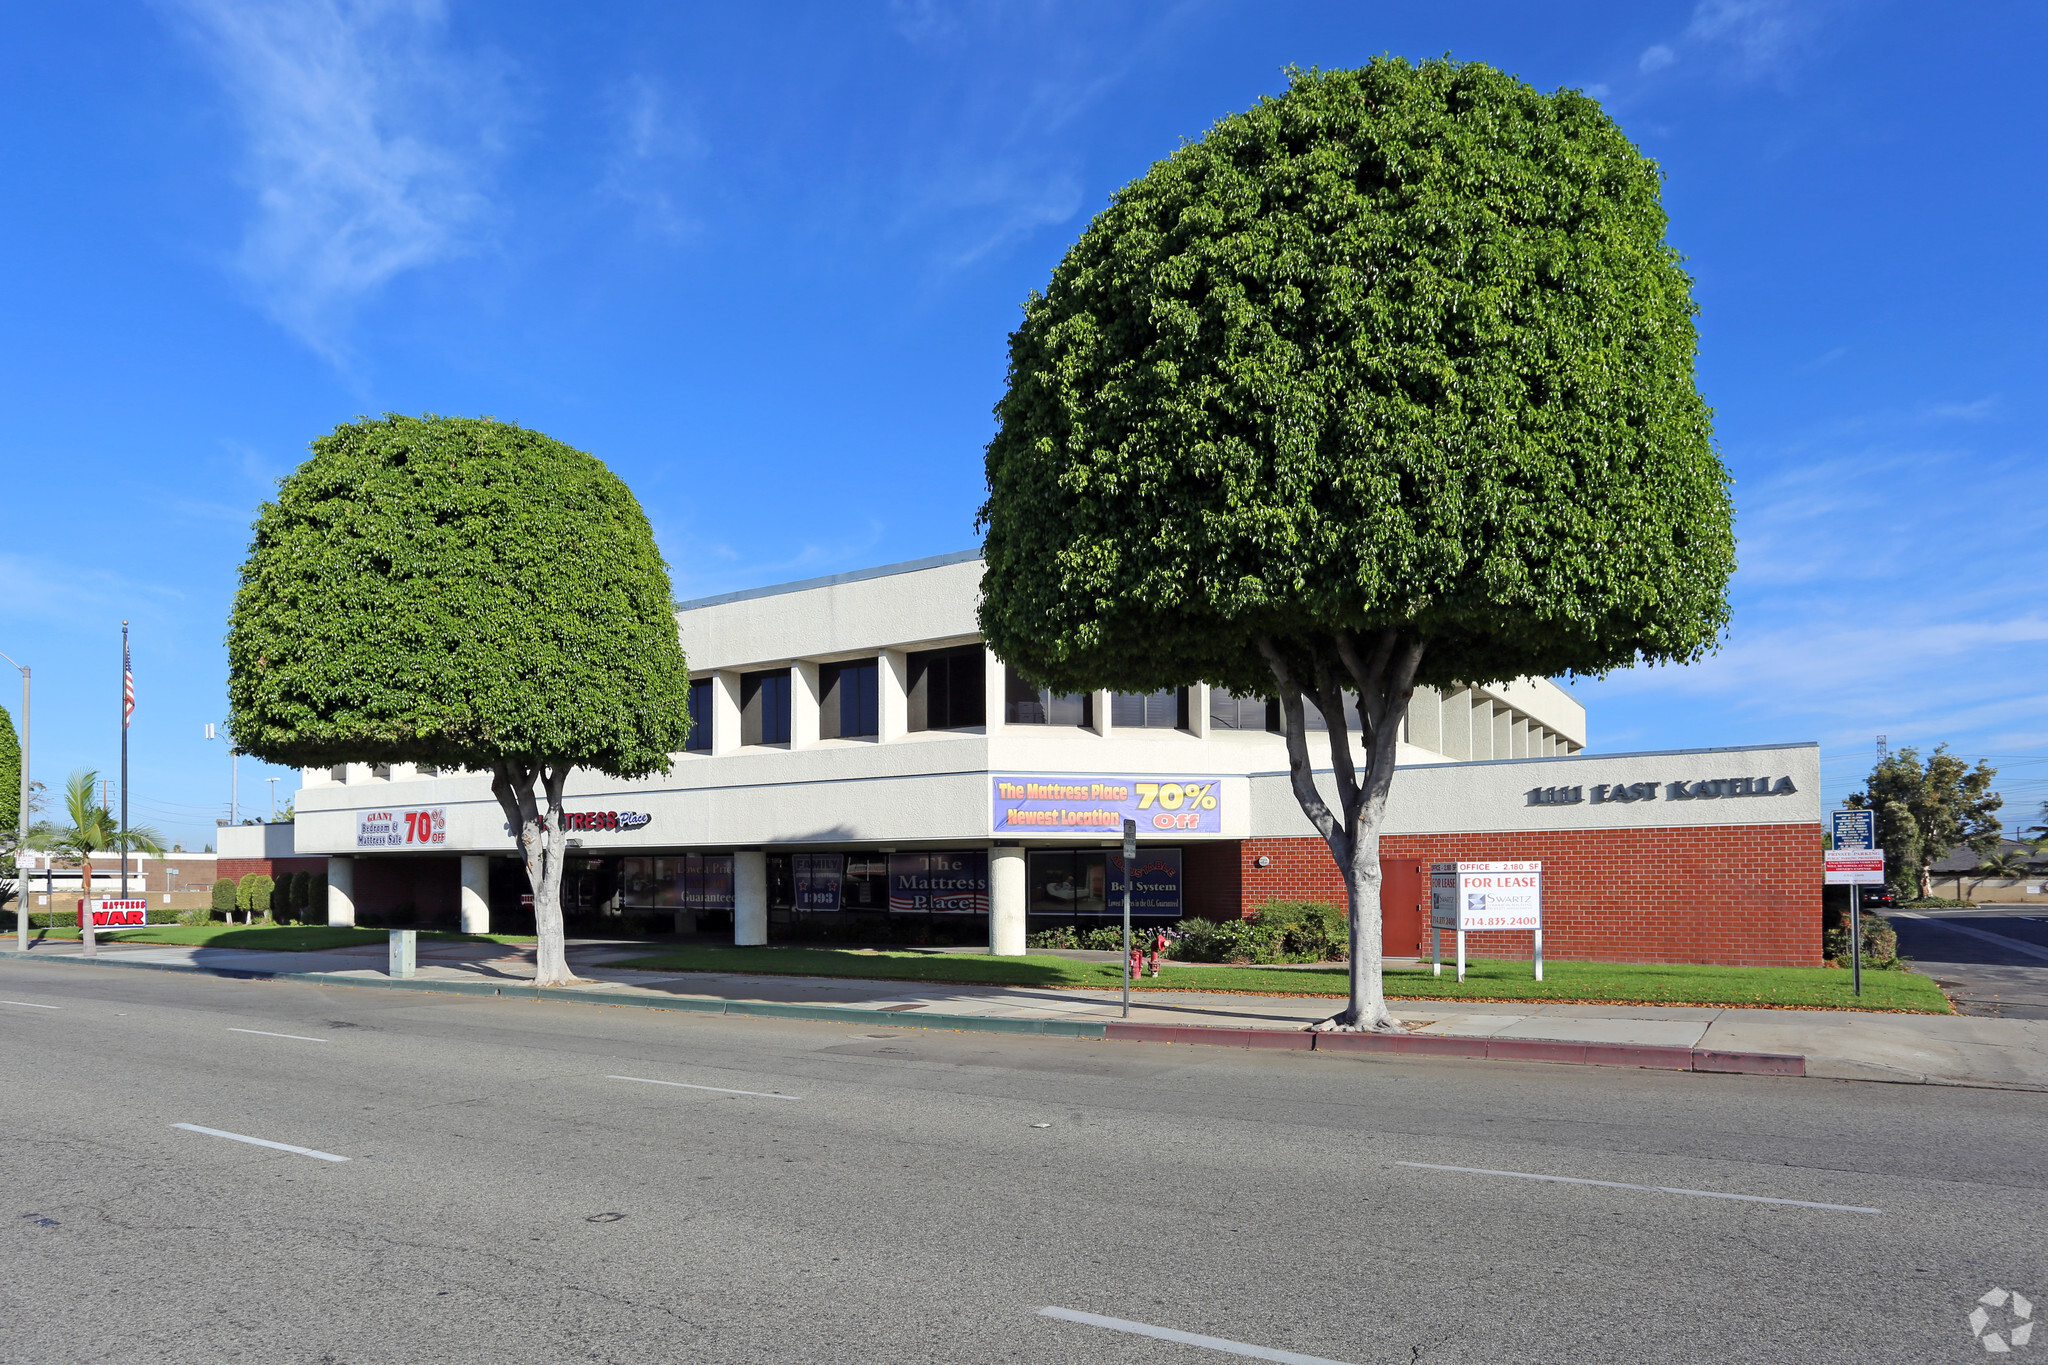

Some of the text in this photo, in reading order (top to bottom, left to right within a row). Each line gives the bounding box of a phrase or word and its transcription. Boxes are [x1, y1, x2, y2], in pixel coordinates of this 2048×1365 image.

[998, 783, 1129, 800] The Mattress Place
[1135, 783, 1217, 810] 70%
[1526, 776, 1797, 806] 1111 EAST KATELLA
[367, 812, 392, 822] GIANT
[619, 811, 649, 827] Place
[1007, 808, 1120, 826] Newest Location
[1153, 813, 1200, 830] Off
[361, 821, 399, 834] Bedroom &
[357, 833, 402, 846] Mattress Sale
[432, 832, 445, 843] OFF
[919, 856, 963, 871] The
[898, 875, 986, 890] Mattress
[1136, 881, 1176, 894] System
[1464, 877, 1537, 888] FOR LEASE
[102, 901, 146, 909] MATTRESS
[804, 892, 833, 904] 1993
[912, 895, 971, 910] Place
[91, 911, 144, 925] WAR
[1464, 917, 1537, 926] 714.835.2400
